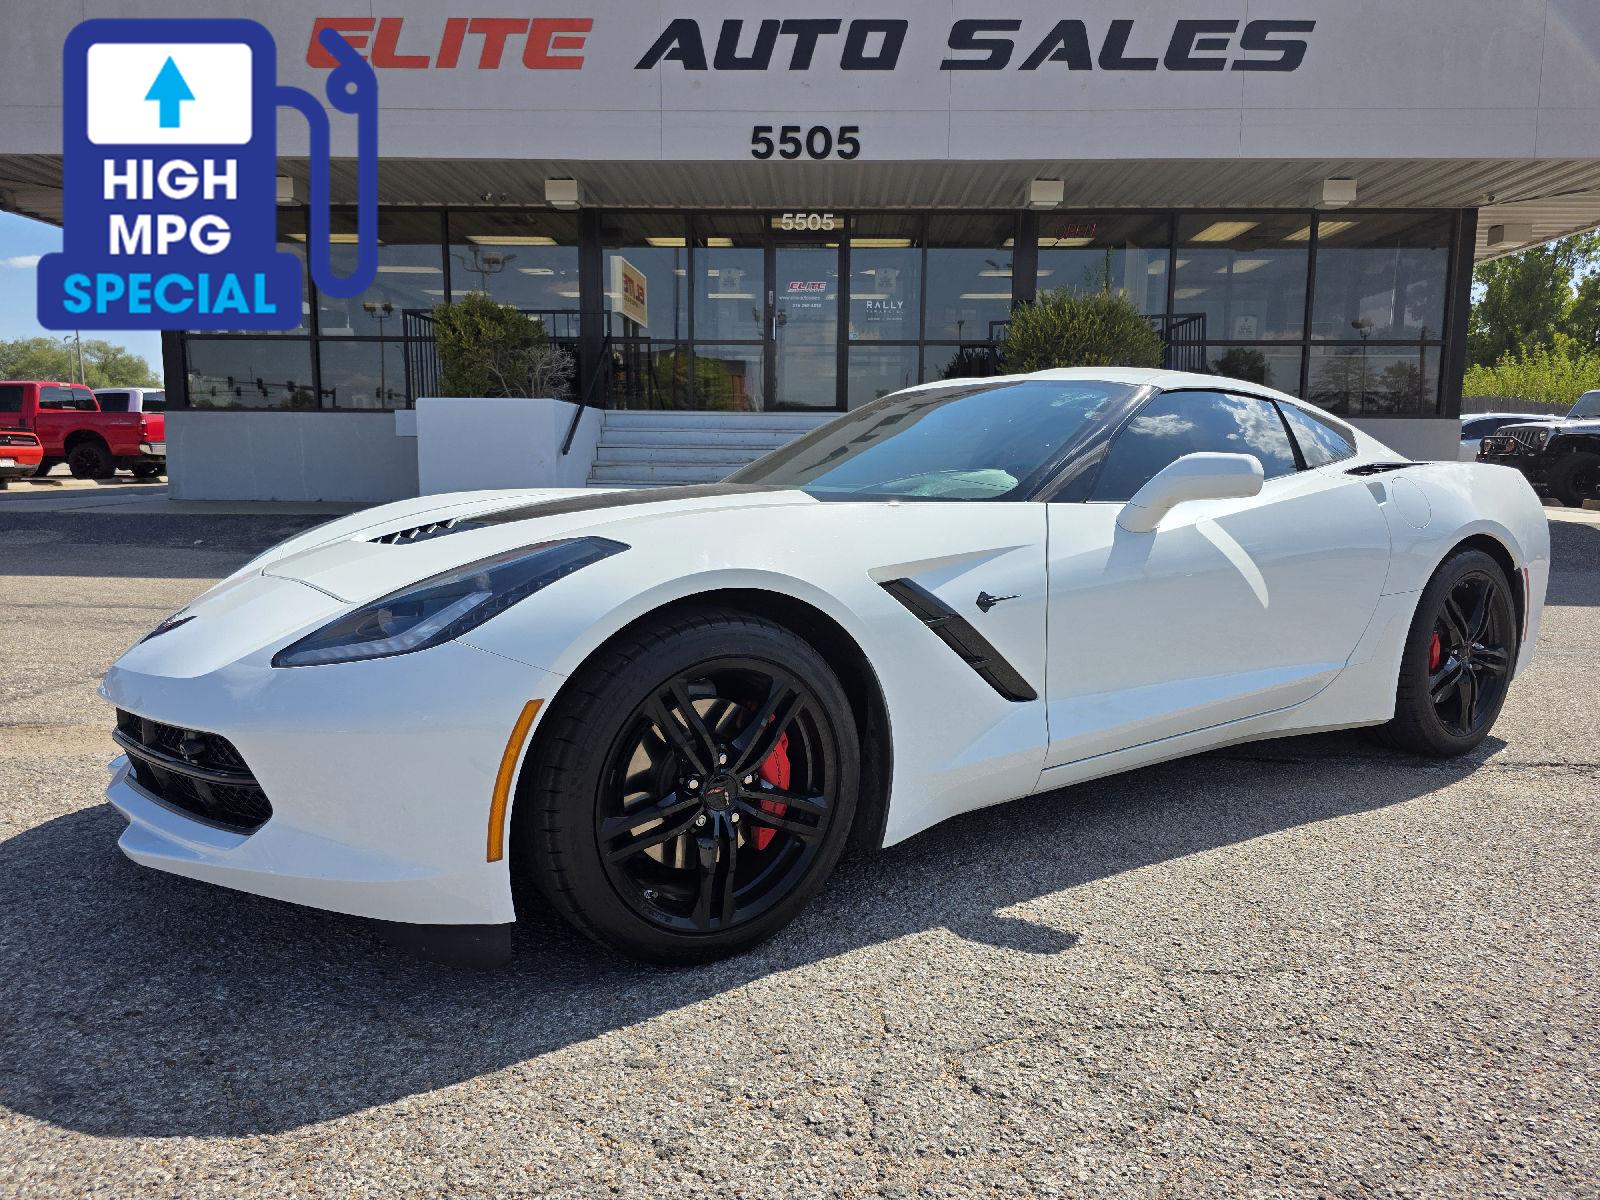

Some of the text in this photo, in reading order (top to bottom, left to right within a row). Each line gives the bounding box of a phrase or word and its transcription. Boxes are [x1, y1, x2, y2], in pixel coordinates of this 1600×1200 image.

[306, 18, 1316, 71] ELITE AUTO SALES
[751, 126, 861, 160] 5505
[781, 213, 835, 231] 5505
[789, 281, 827, 290] ELITE
[866, 300, 904, 309] RALLY
